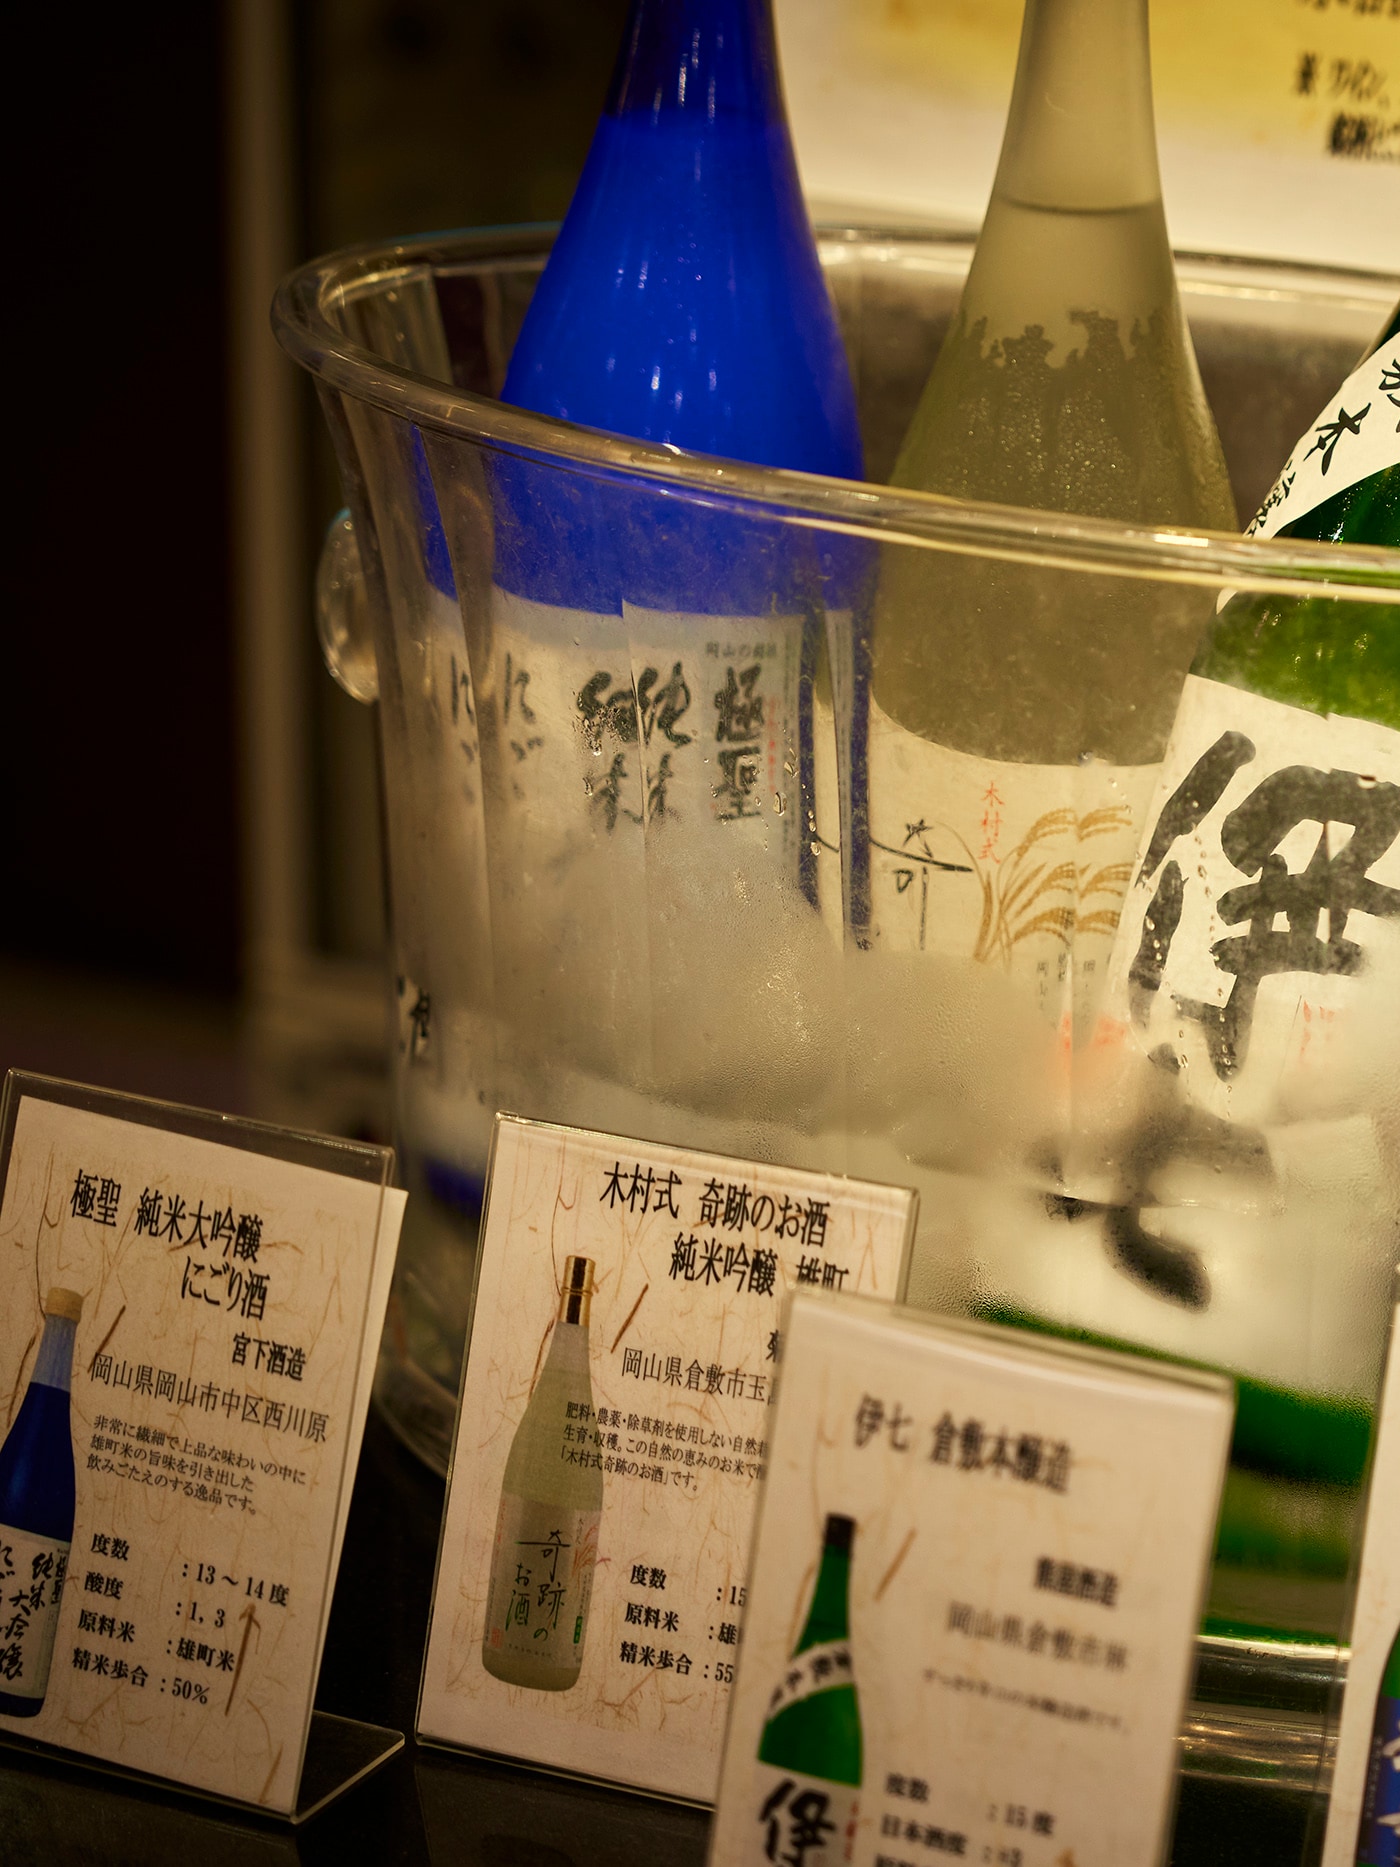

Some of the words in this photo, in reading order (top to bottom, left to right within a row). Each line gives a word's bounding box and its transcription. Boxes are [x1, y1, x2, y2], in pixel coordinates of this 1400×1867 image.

[977, 780, 1005, 864] 木村式
[70, 1168, 122, 1228] 極聖
[134, 1186, 264, 1263] 純米大吟醸
[599, 1161, 683, 1220] 木村式
[699, 1178, 831, 1248] 奇跡のお酒
[181, 1255, 271, 1321] にごり酒
[668, 1231, 779, 1298] 純米吟醸
[231, 1331, 308, 1382] 宮下酒造
[621, 1346, 777, 1406] 岡山県倉敷市玉
[90, 1351, 330, 1444] 岡山県岡山市中区西川原
[89, 1433, 254, 1493] 雄町米の旨味を引き出した
[93, 1414, 306, 1486] 非常に繊細で上品な味わいの中に
[90, 1533, 130, 1562] 度数
[630, 1564, 667, 1591] 度数
[83, 1570, 124, 1600] 酸度
[77, 1608, 136, 1643] 原料米
[624, 1602, 680, 1633] 原料米
[71, 1647, 149, 1688] 精米歩合
[619, 1640, 693, 1677] 精米歩合
